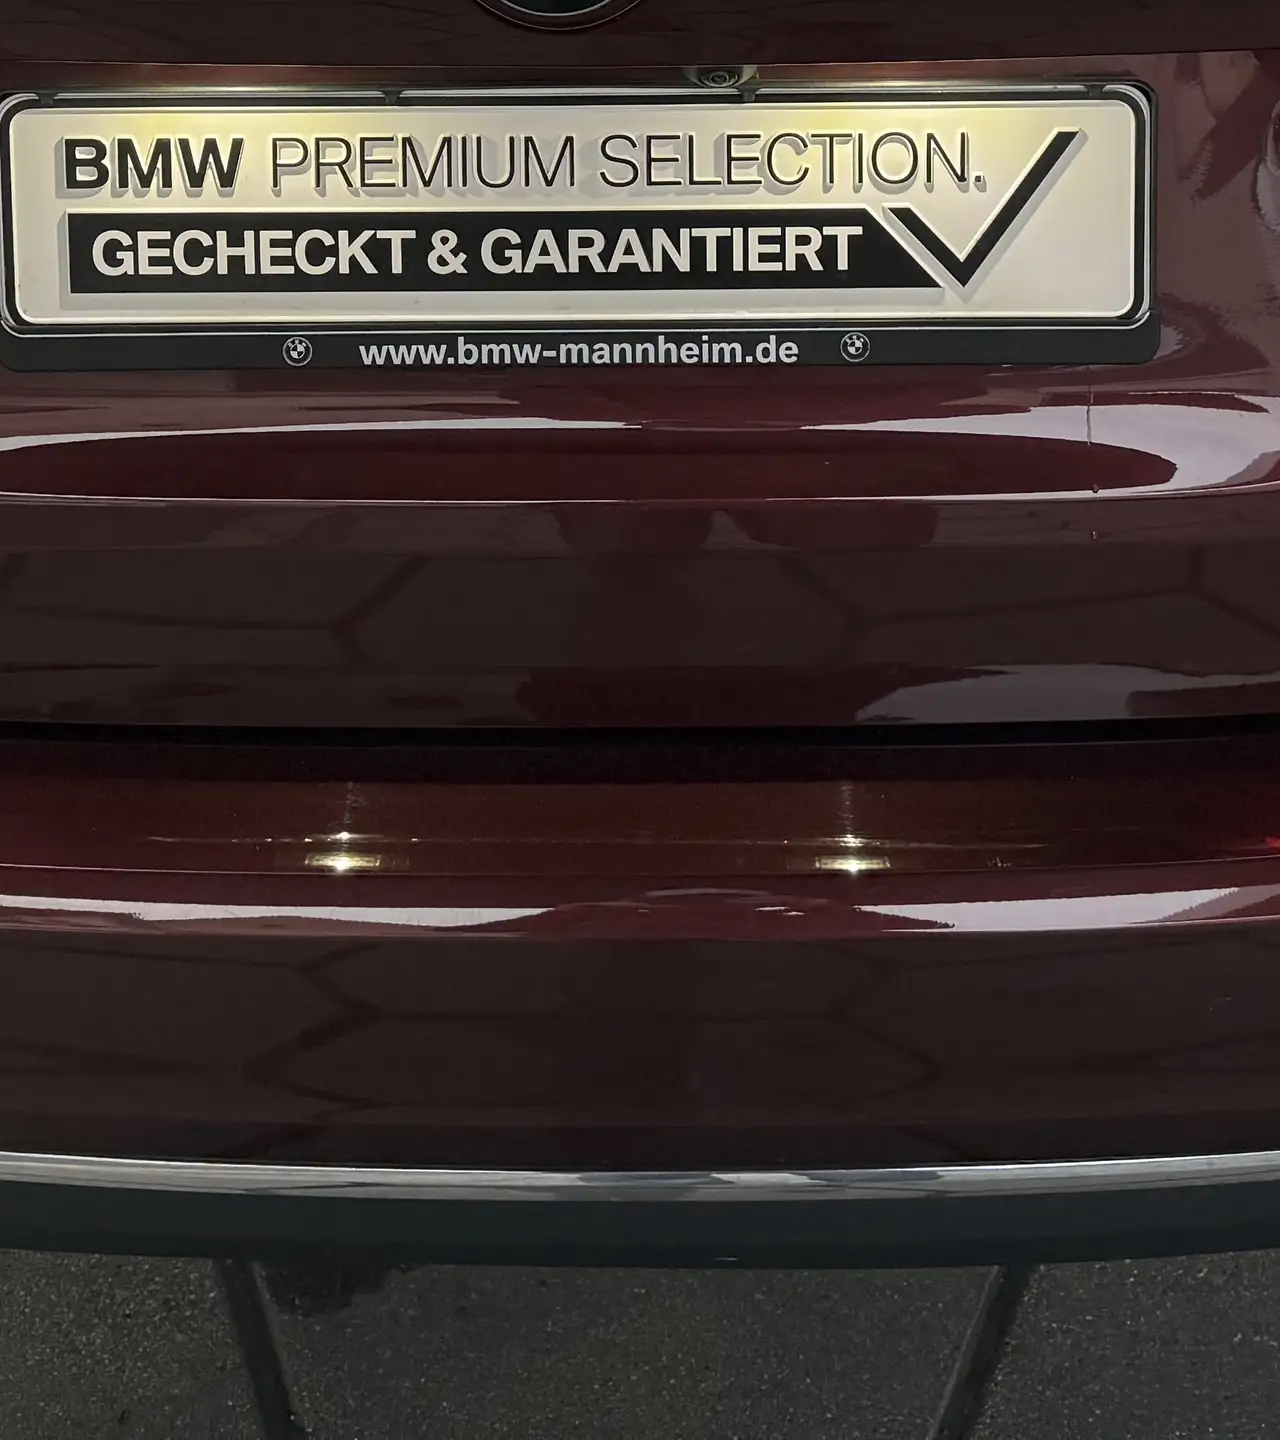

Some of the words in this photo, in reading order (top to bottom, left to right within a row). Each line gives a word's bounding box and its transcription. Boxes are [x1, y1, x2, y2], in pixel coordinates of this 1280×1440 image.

[63, 136, 244, 190] BMW
[271, 133, 576, 189] PREMIUM
[599, 131, 984, 188] SELECTION.
[91, 229, 416, 276] GECHECKT
[426, 229, 468, 276] &
[480, 226, 864, 274] GARANTIERT
[358, 335, 800, 366] www.bmw-mannheim.de
